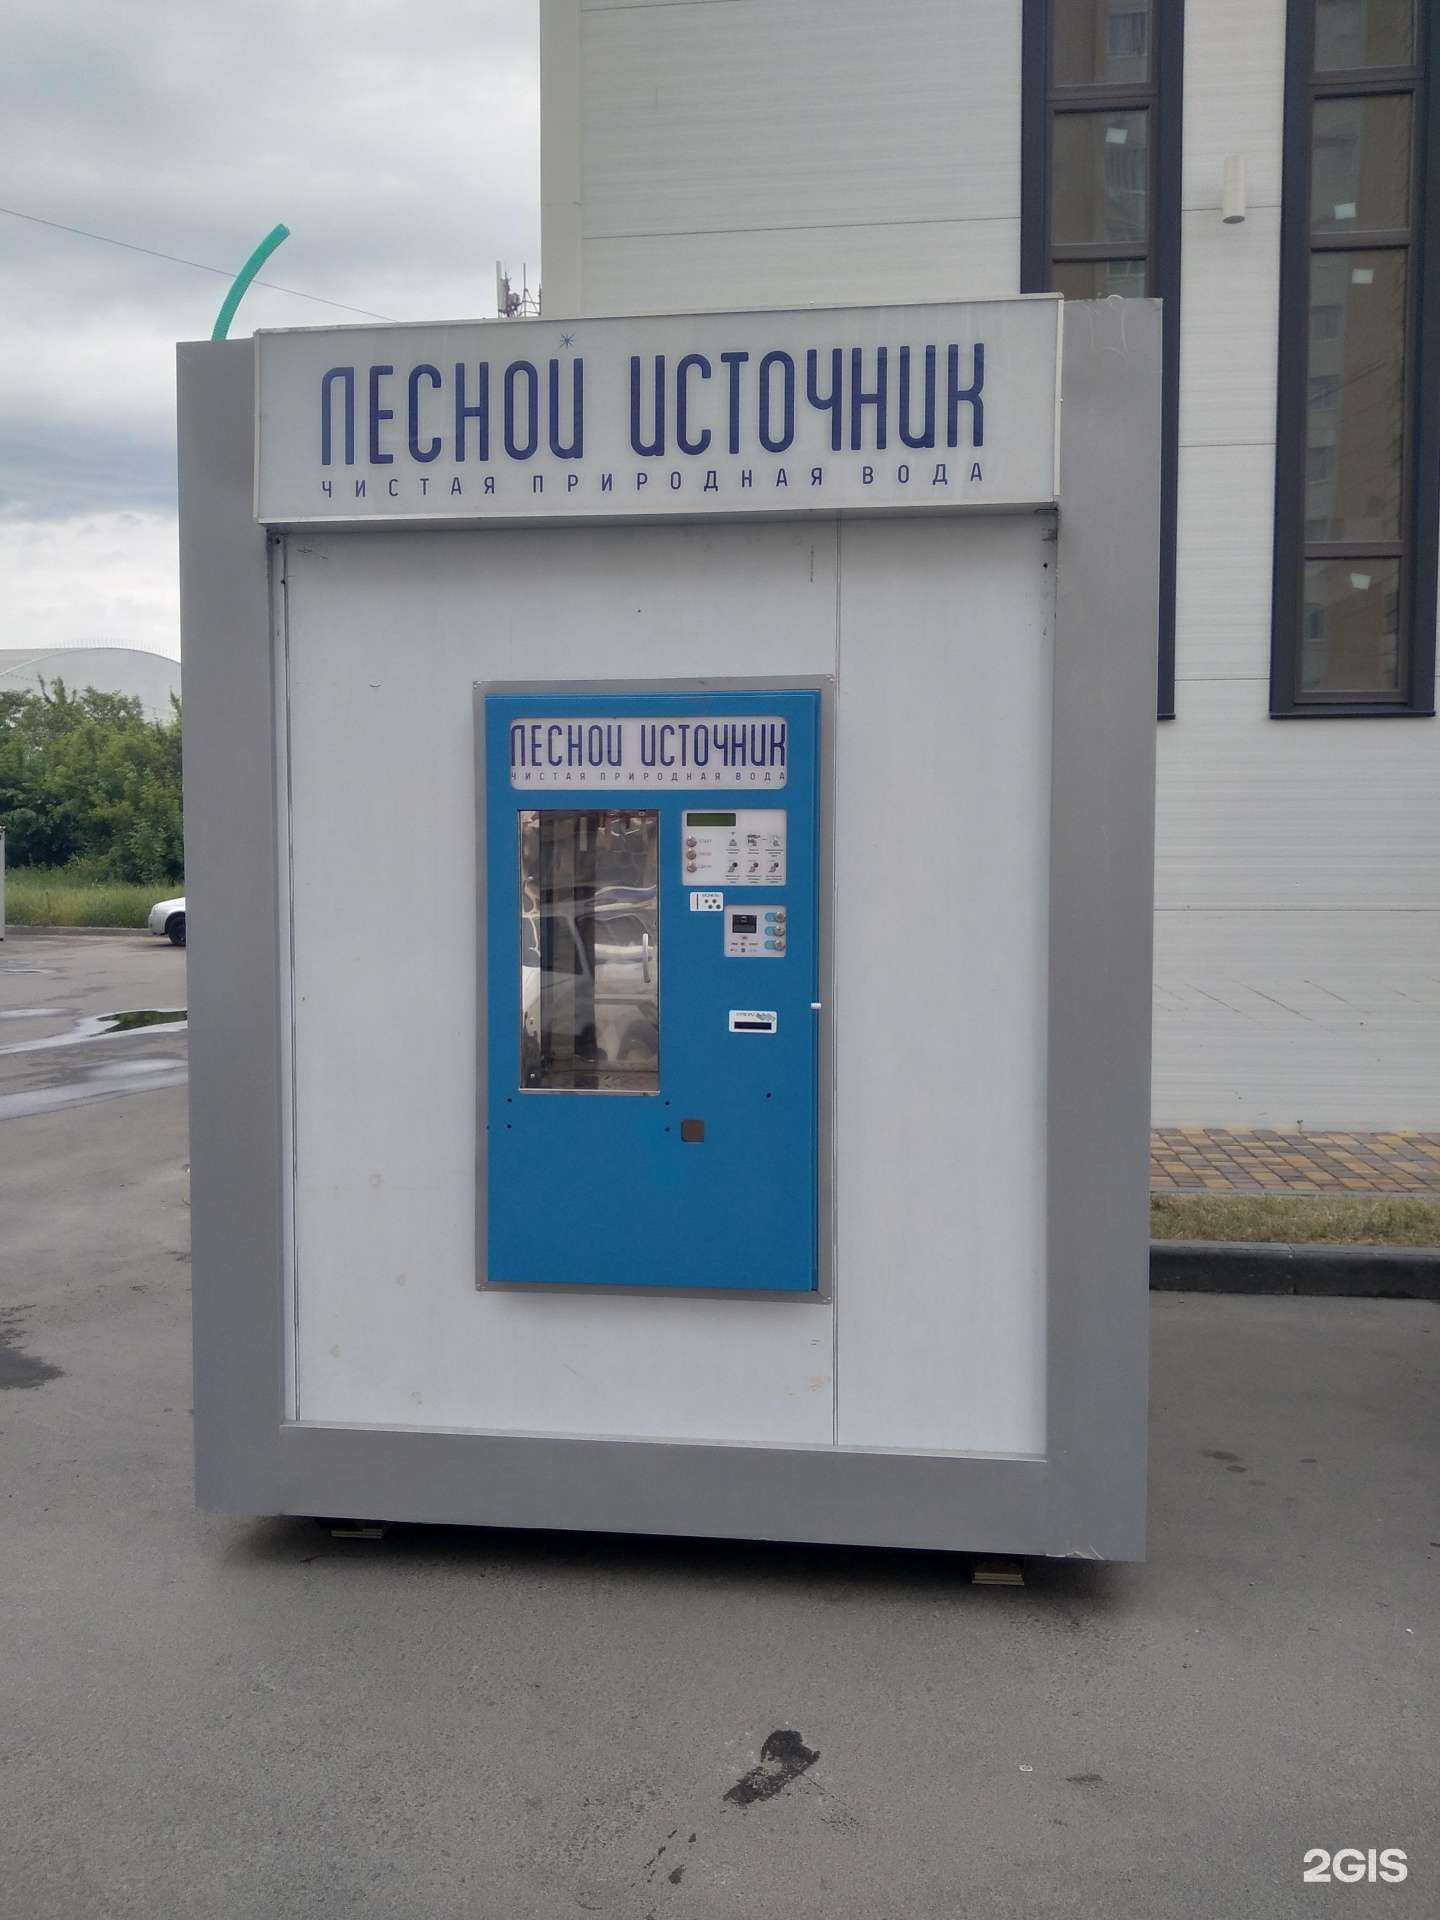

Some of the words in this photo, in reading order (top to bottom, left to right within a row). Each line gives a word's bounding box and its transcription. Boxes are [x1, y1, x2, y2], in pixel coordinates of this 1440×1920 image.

[321, 332, 584, 466] ЛЕСНОЙ
[630, 342, 985, 457] ИСТОЧНИК
[321, 476, 495, 498] ЧИСТАЯ
[532, 466, 823, 493] ПРИРОДНАЯ
[862, 462, 983, 485] ВОДА
[641, 723, 786, 767] ИСТОЧНИК
[511, 771, 586, 782] ЧИСТАЯ
[600, 771, 721, 782] ПРИРОДНАЯ
[735, 771, 785, 781] ВОДА
